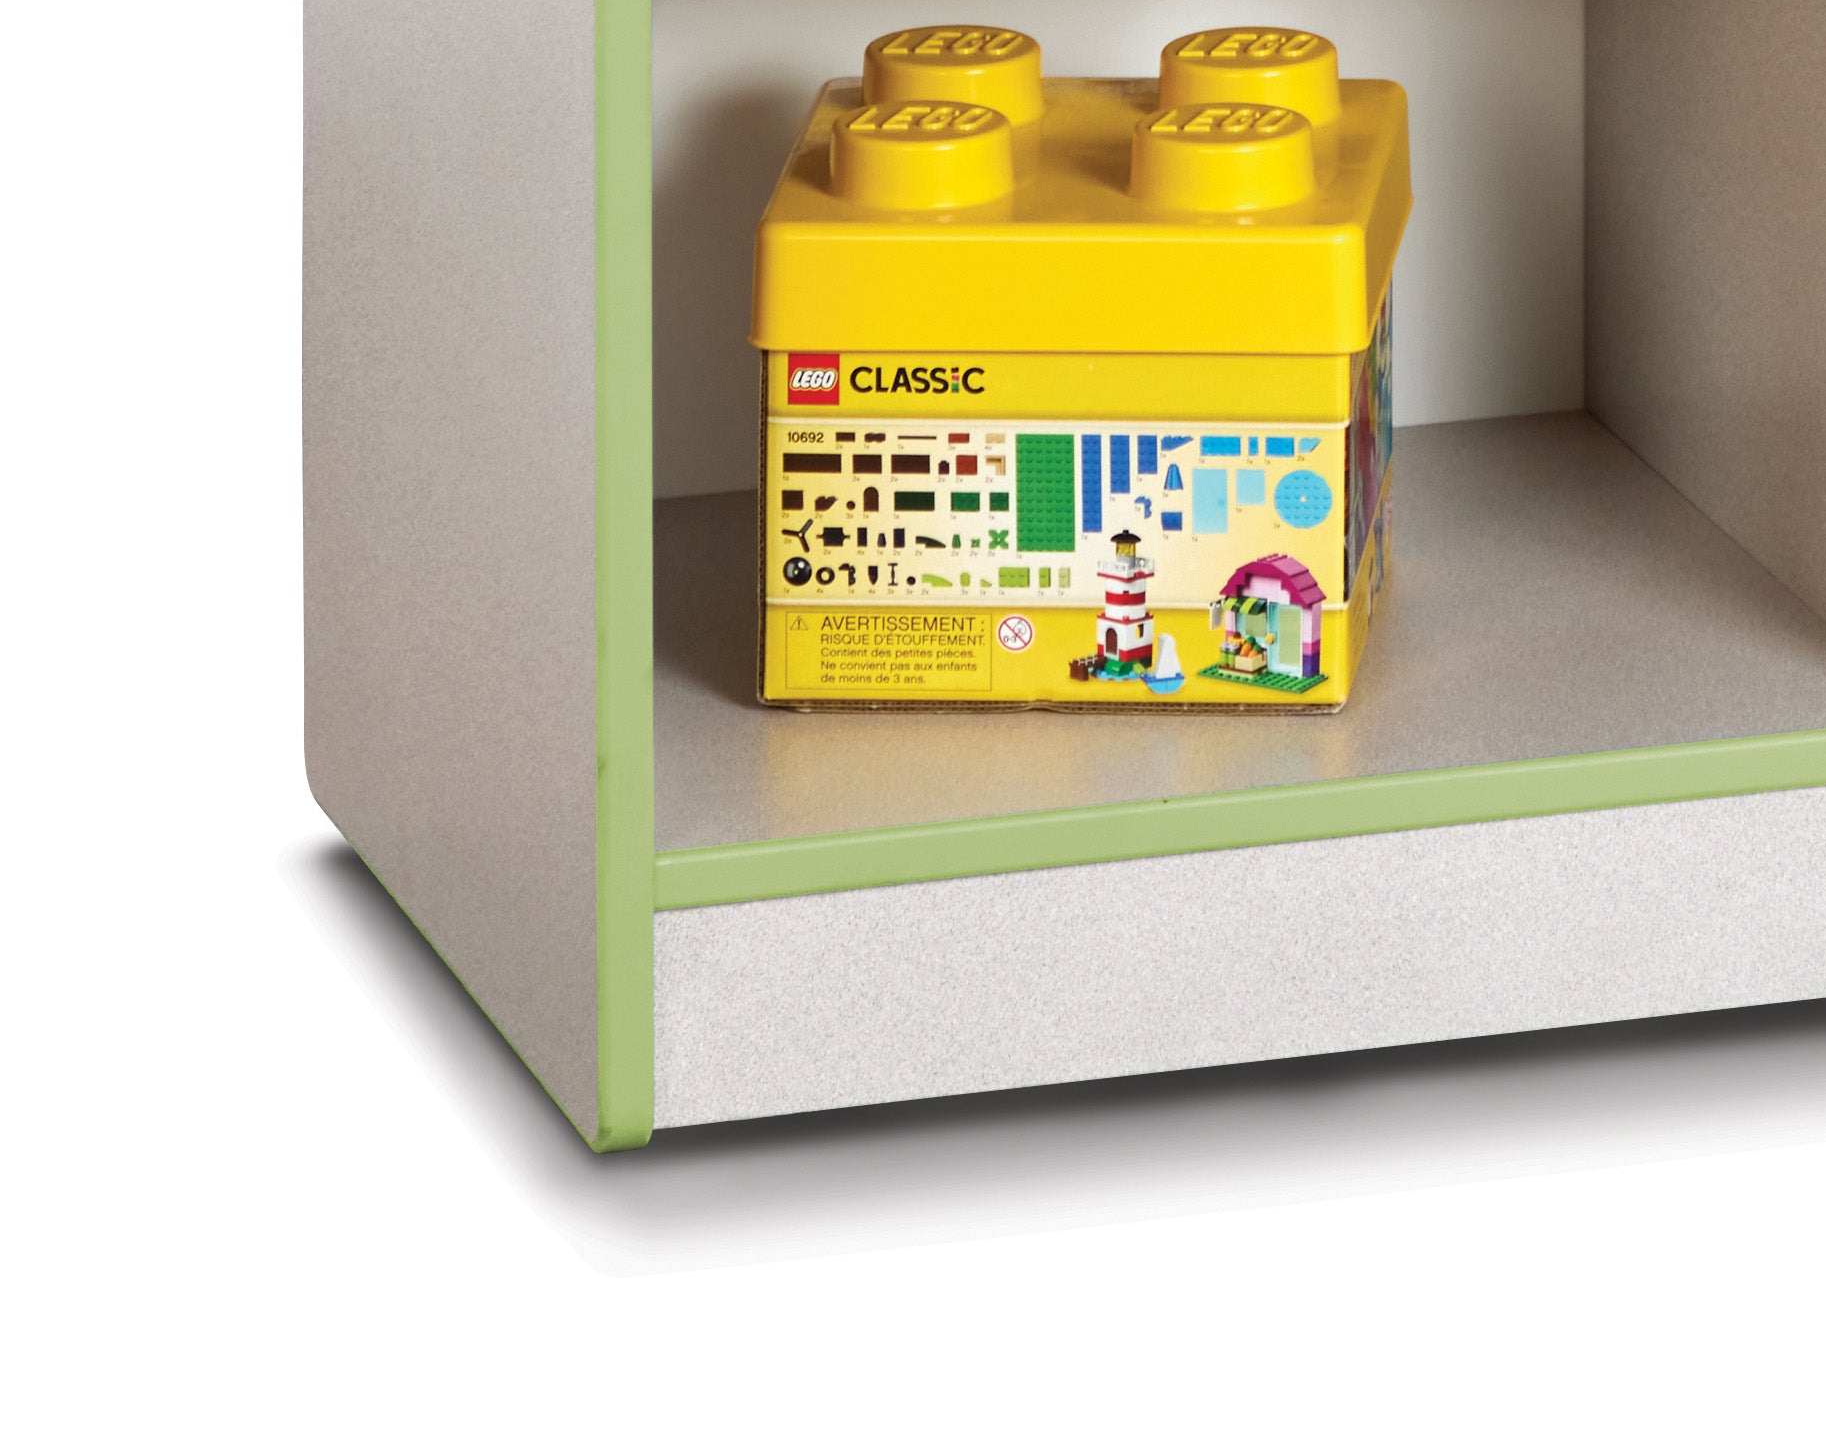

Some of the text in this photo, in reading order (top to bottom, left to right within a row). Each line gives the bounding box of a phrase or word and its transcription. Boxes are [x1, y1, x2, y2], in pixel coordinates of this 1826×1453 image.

[882, 31, 1024, 56] LEGO
[1177, 33, 1320, 57] LEGO
[849, 106, 994, 130] LEGO
[1151, 108, 1294, 133] LEGO
[790, 368, 836, 390] LEGO
[788, 432, 824, 443] 10692
[821, 616, 976, 631] AVERTISSEMENT
[821, 634, 870, 645] RISQUE
[821, 648, 867, 658] Contient
[871, 648, 891, 658] des
[895, 648, 933, 660] petites
[821, 661, 977, 673] Ne convient pas aux enfants
[821, 674, 925, 683] de moins de 3 ans.
